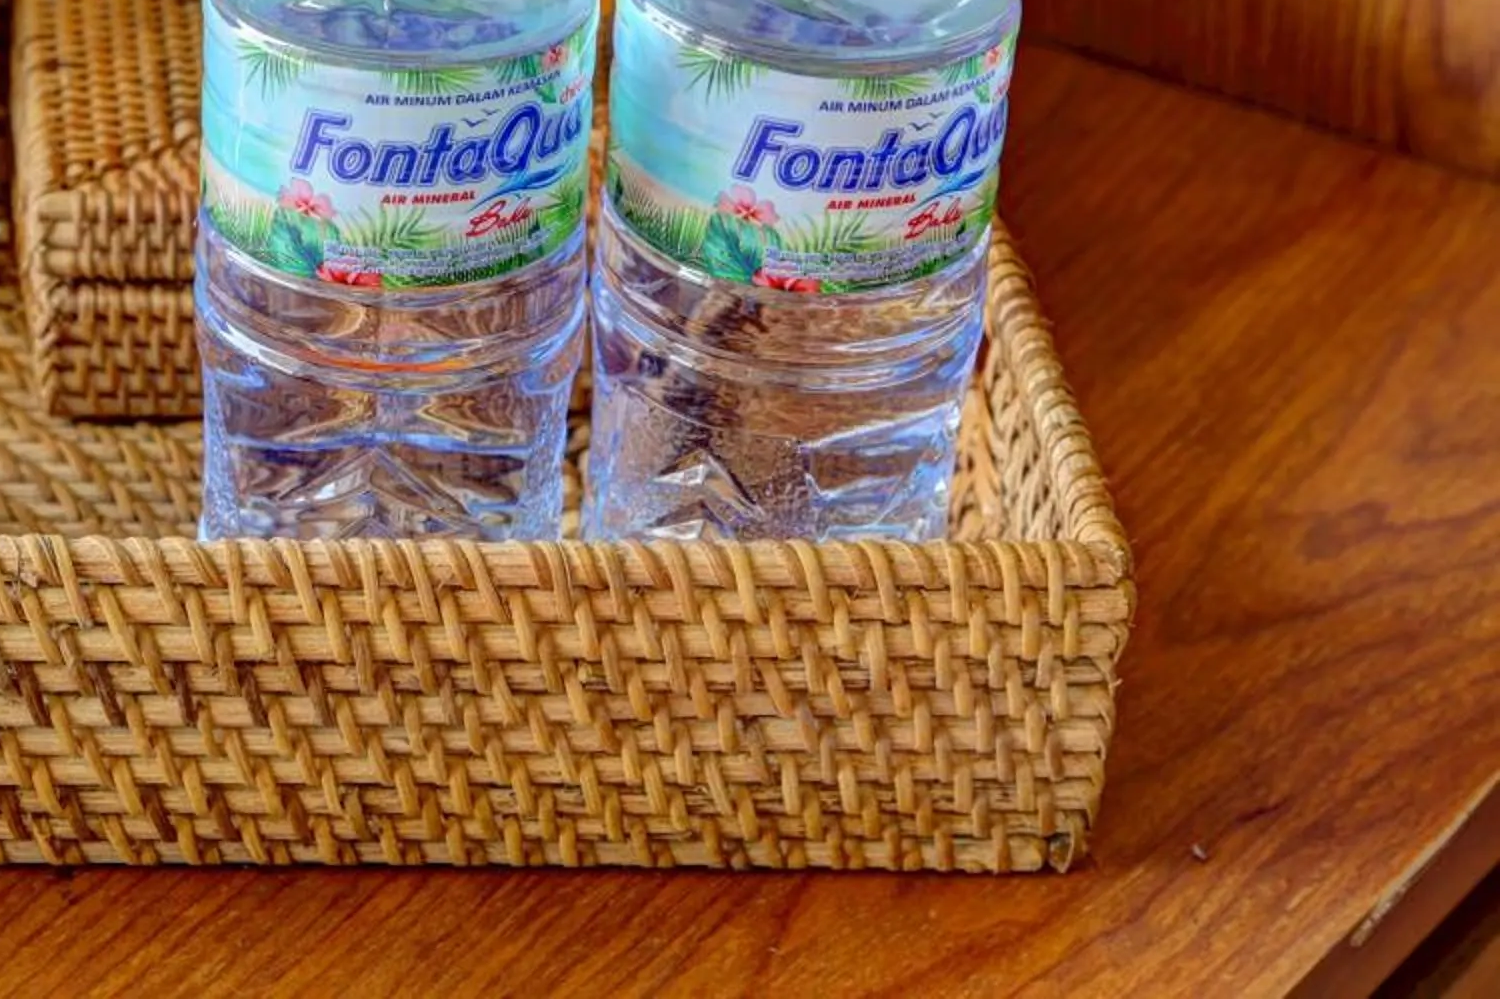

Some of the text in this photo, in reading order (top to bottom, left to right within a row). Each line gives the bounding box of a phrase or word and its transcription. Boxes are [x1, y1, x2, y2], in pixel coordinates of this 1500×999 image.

[365, 93, 390, 105] AIR
[394, 94, 452, 106] MINUM
[455, 87, 505, 105] DALAM
[818, 100, 844, 113] AIR
[847, 97, 902, 113] MINUM
[904, 90, 950, 110] DALAM
[381, 190, 477, 205] AIR MINERAL
[827, 193, 917, 210] AIR MINERAL
